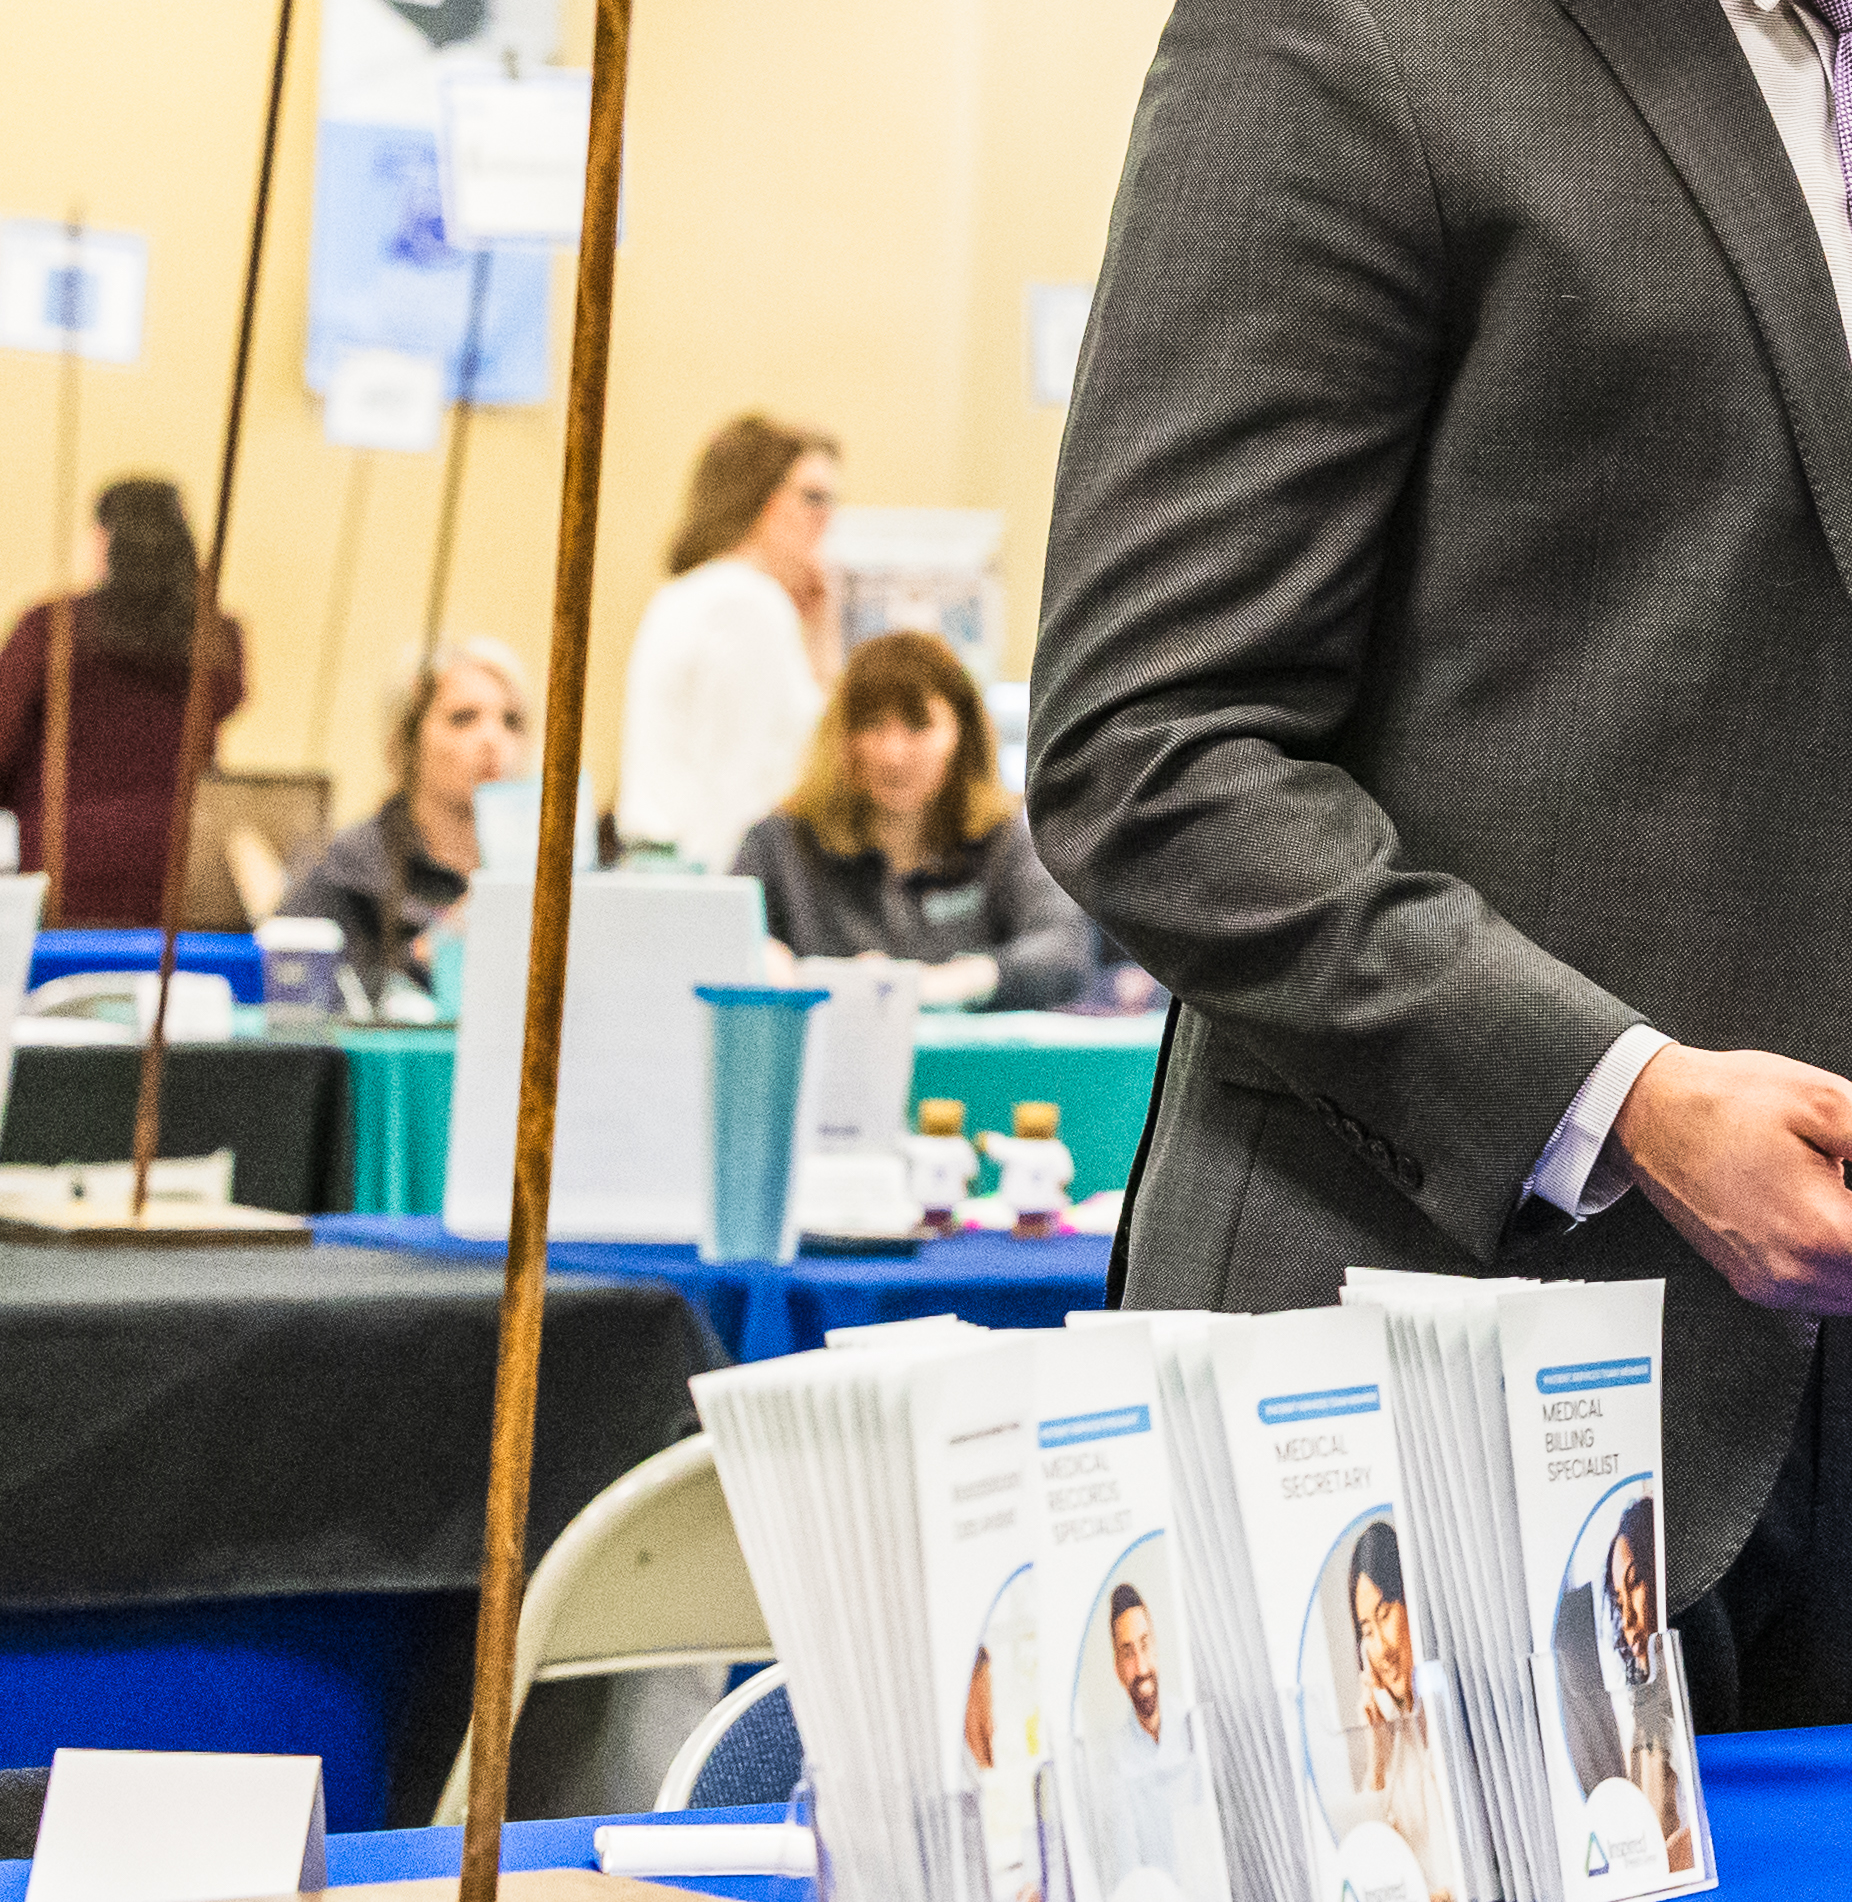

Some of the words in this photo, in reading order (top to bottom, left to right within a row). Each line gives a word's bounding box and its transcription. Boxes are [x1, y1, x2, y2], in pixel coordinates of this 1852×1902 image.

[1542, 1398, 1603, 1422] MEDICAL
[1545, 1427, 1595, 1453] BILLING
[1547, 1453, 1620, 1482] SPECIALIST
